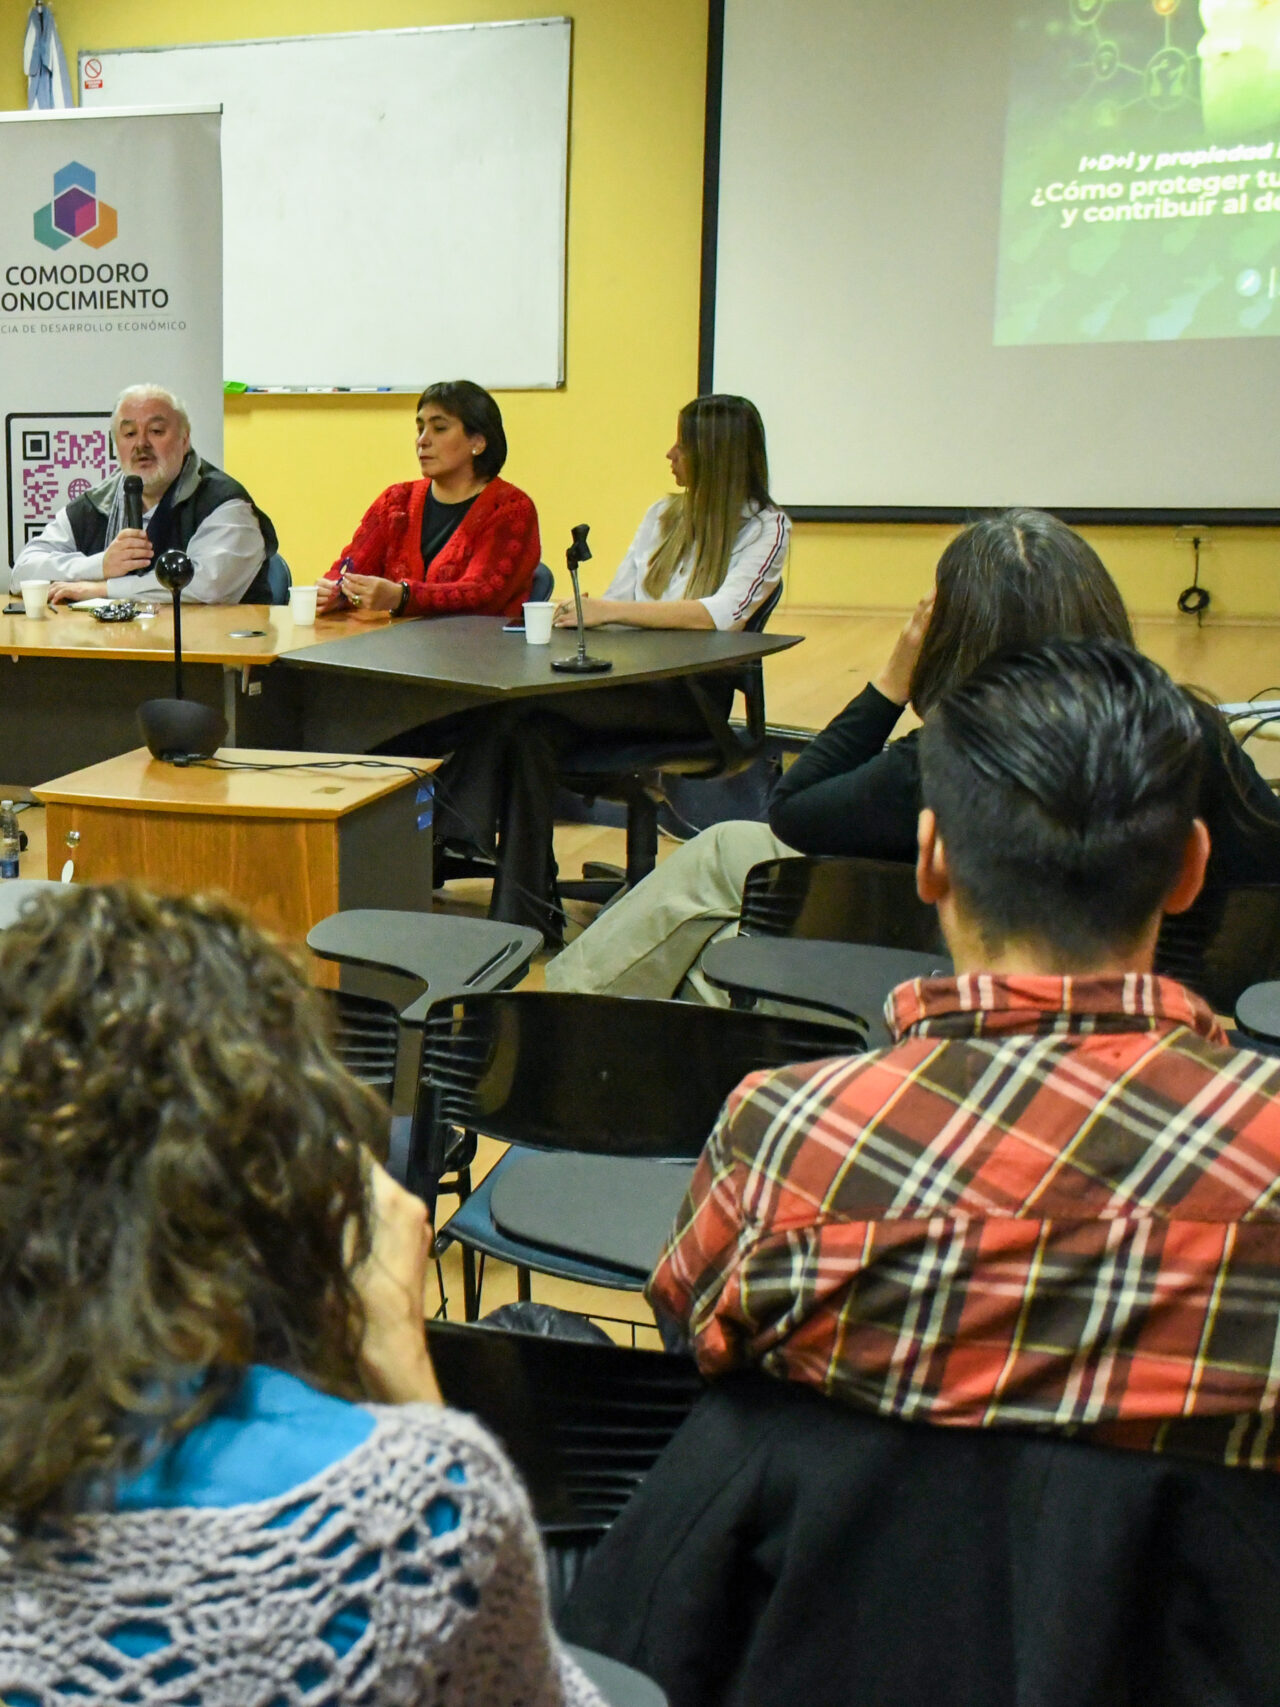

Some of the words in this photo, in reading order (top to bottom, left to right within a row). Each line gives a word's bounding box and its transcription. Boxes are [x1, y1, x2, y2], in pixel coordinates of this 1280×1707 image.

[1135, 153, 1153, 173] y
[1154, 142, 1274, 171] propiedad
[1031, 180, 1124, 207] ¿Cómo
[1129, 173, 1251, 200] proteger
[1060, 208, 1078, 229] y
[1083, 197, 1218, 223] contribuir
[1222, 192, 1247, 214] al
[6, 262, 149, 286] COMODORO
[22, 323, 36, 334] DE
[40, 322, 113, 333] DESARROLLO
[117, 320, 187, 332] ECONÓMICO
